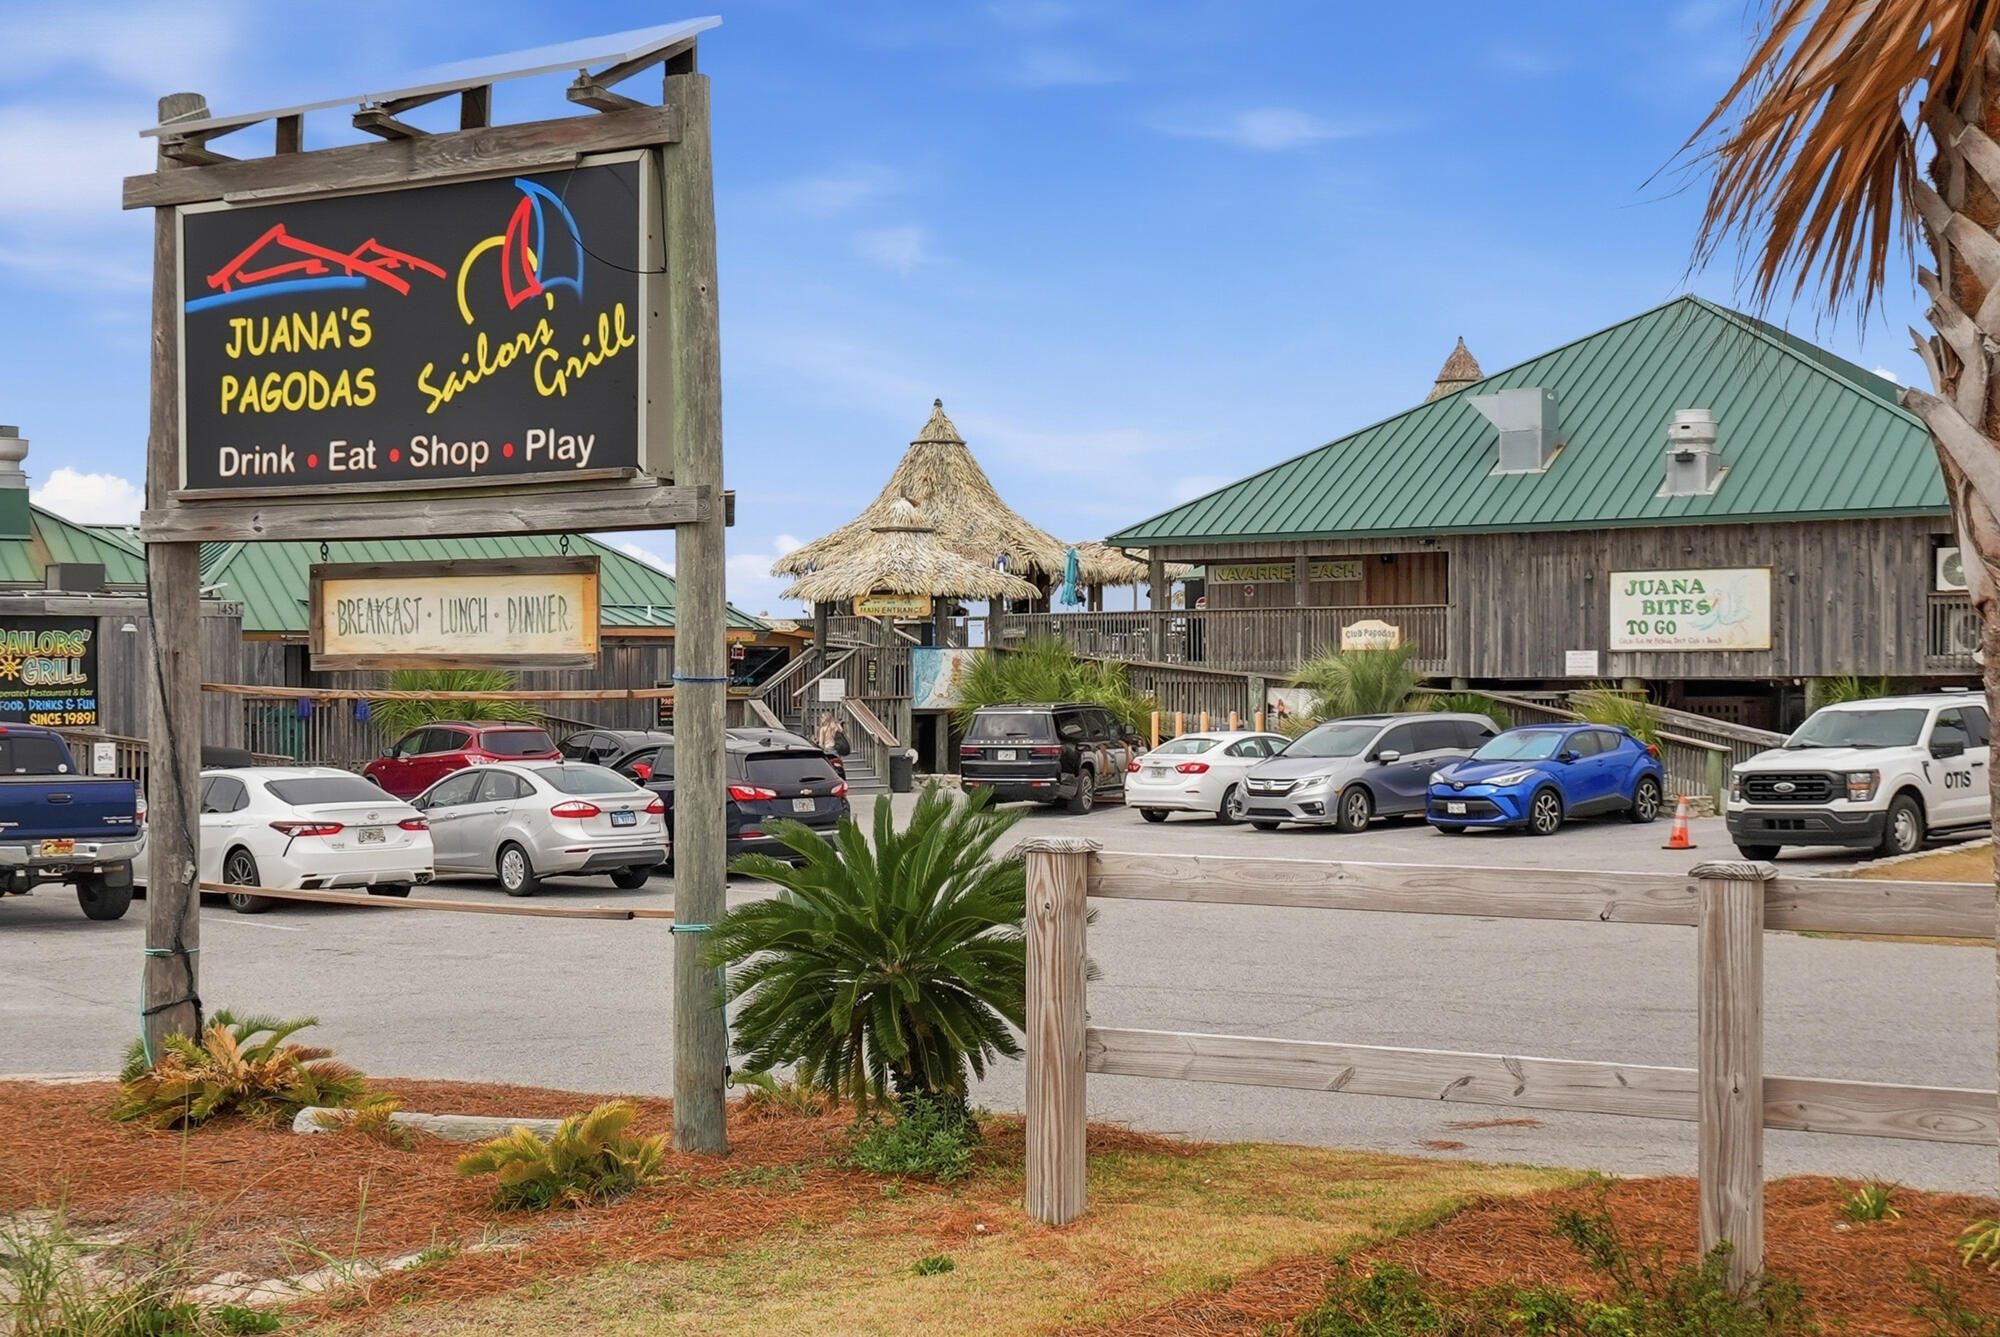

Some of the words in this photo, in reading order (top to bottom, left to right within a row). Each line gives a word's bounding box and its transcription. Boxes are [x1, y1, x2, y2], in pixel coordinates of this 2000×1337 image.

[225, 307, 373, 359] JUANA'S
[418, 291, 554, 414] Sailors'
[534, 302, 636, 398] Grill
[221, 368, 376, 414] PAGODAS
[219, 444, 296, 477] Drink
[328, 440, 377, 472] Eat
[409, 435, 489, 472] Shop
[526, 429, 596, 469] Play
[1213, 565, 1292, 582] NAVARRE
[1624, 578, 1706, 597] JUANA
[217, 603, 239, 615] 1451
[337, 597, 423, 636] BREAKFAST
[439, 597, 488, 635] LUNCH
[860, 606, 880, 614] MAIN
[881, 606, 923, 614] ENTRANCE
[1641, 599, 1711, 616] BITES
[1345, 629, 1362, 639] Club
[1363, 628, 1395, 639] Pagodas
[1626, 619, 1649, 635] TO
[1654, 619, 1678, 635] GO
[21, 656, 88, 686] GRILL
[73, 688, 79, 697] &
[80, 688, 94, 697] Bar
[28, 698, 64, 711] DRINKS
[65, 698, 75, 710] &
[77, 698, 96, 710] FUN
[29, 712, 62, 726] SINCE
[63, 711, 96, 725] 1989!
[1944, 770, 1971, 789] OTIS
